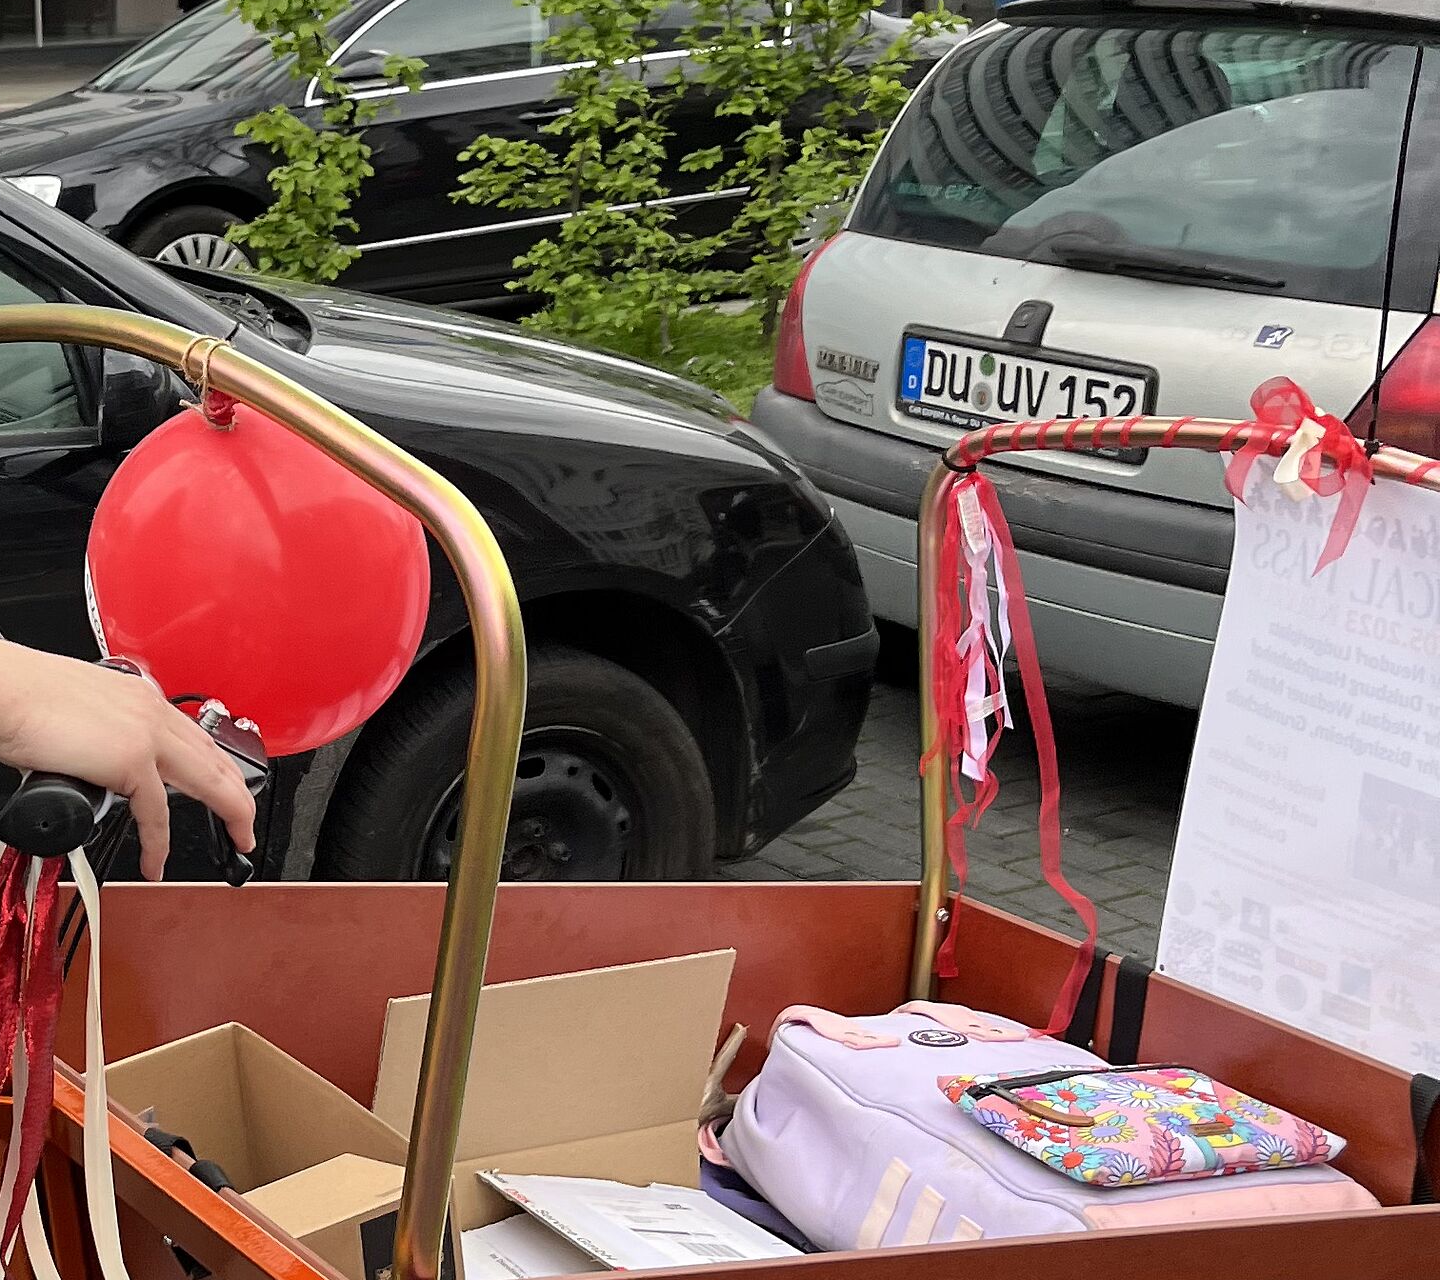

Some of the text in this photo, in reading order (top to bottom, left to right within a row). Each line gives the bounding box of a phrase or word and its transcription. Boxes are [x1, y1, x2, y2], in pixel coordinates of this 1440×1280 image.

[924, 348, 972, 403] DU
[997, 362, 1049, 417] UV
[1056, 375, 1137, 420] 152
